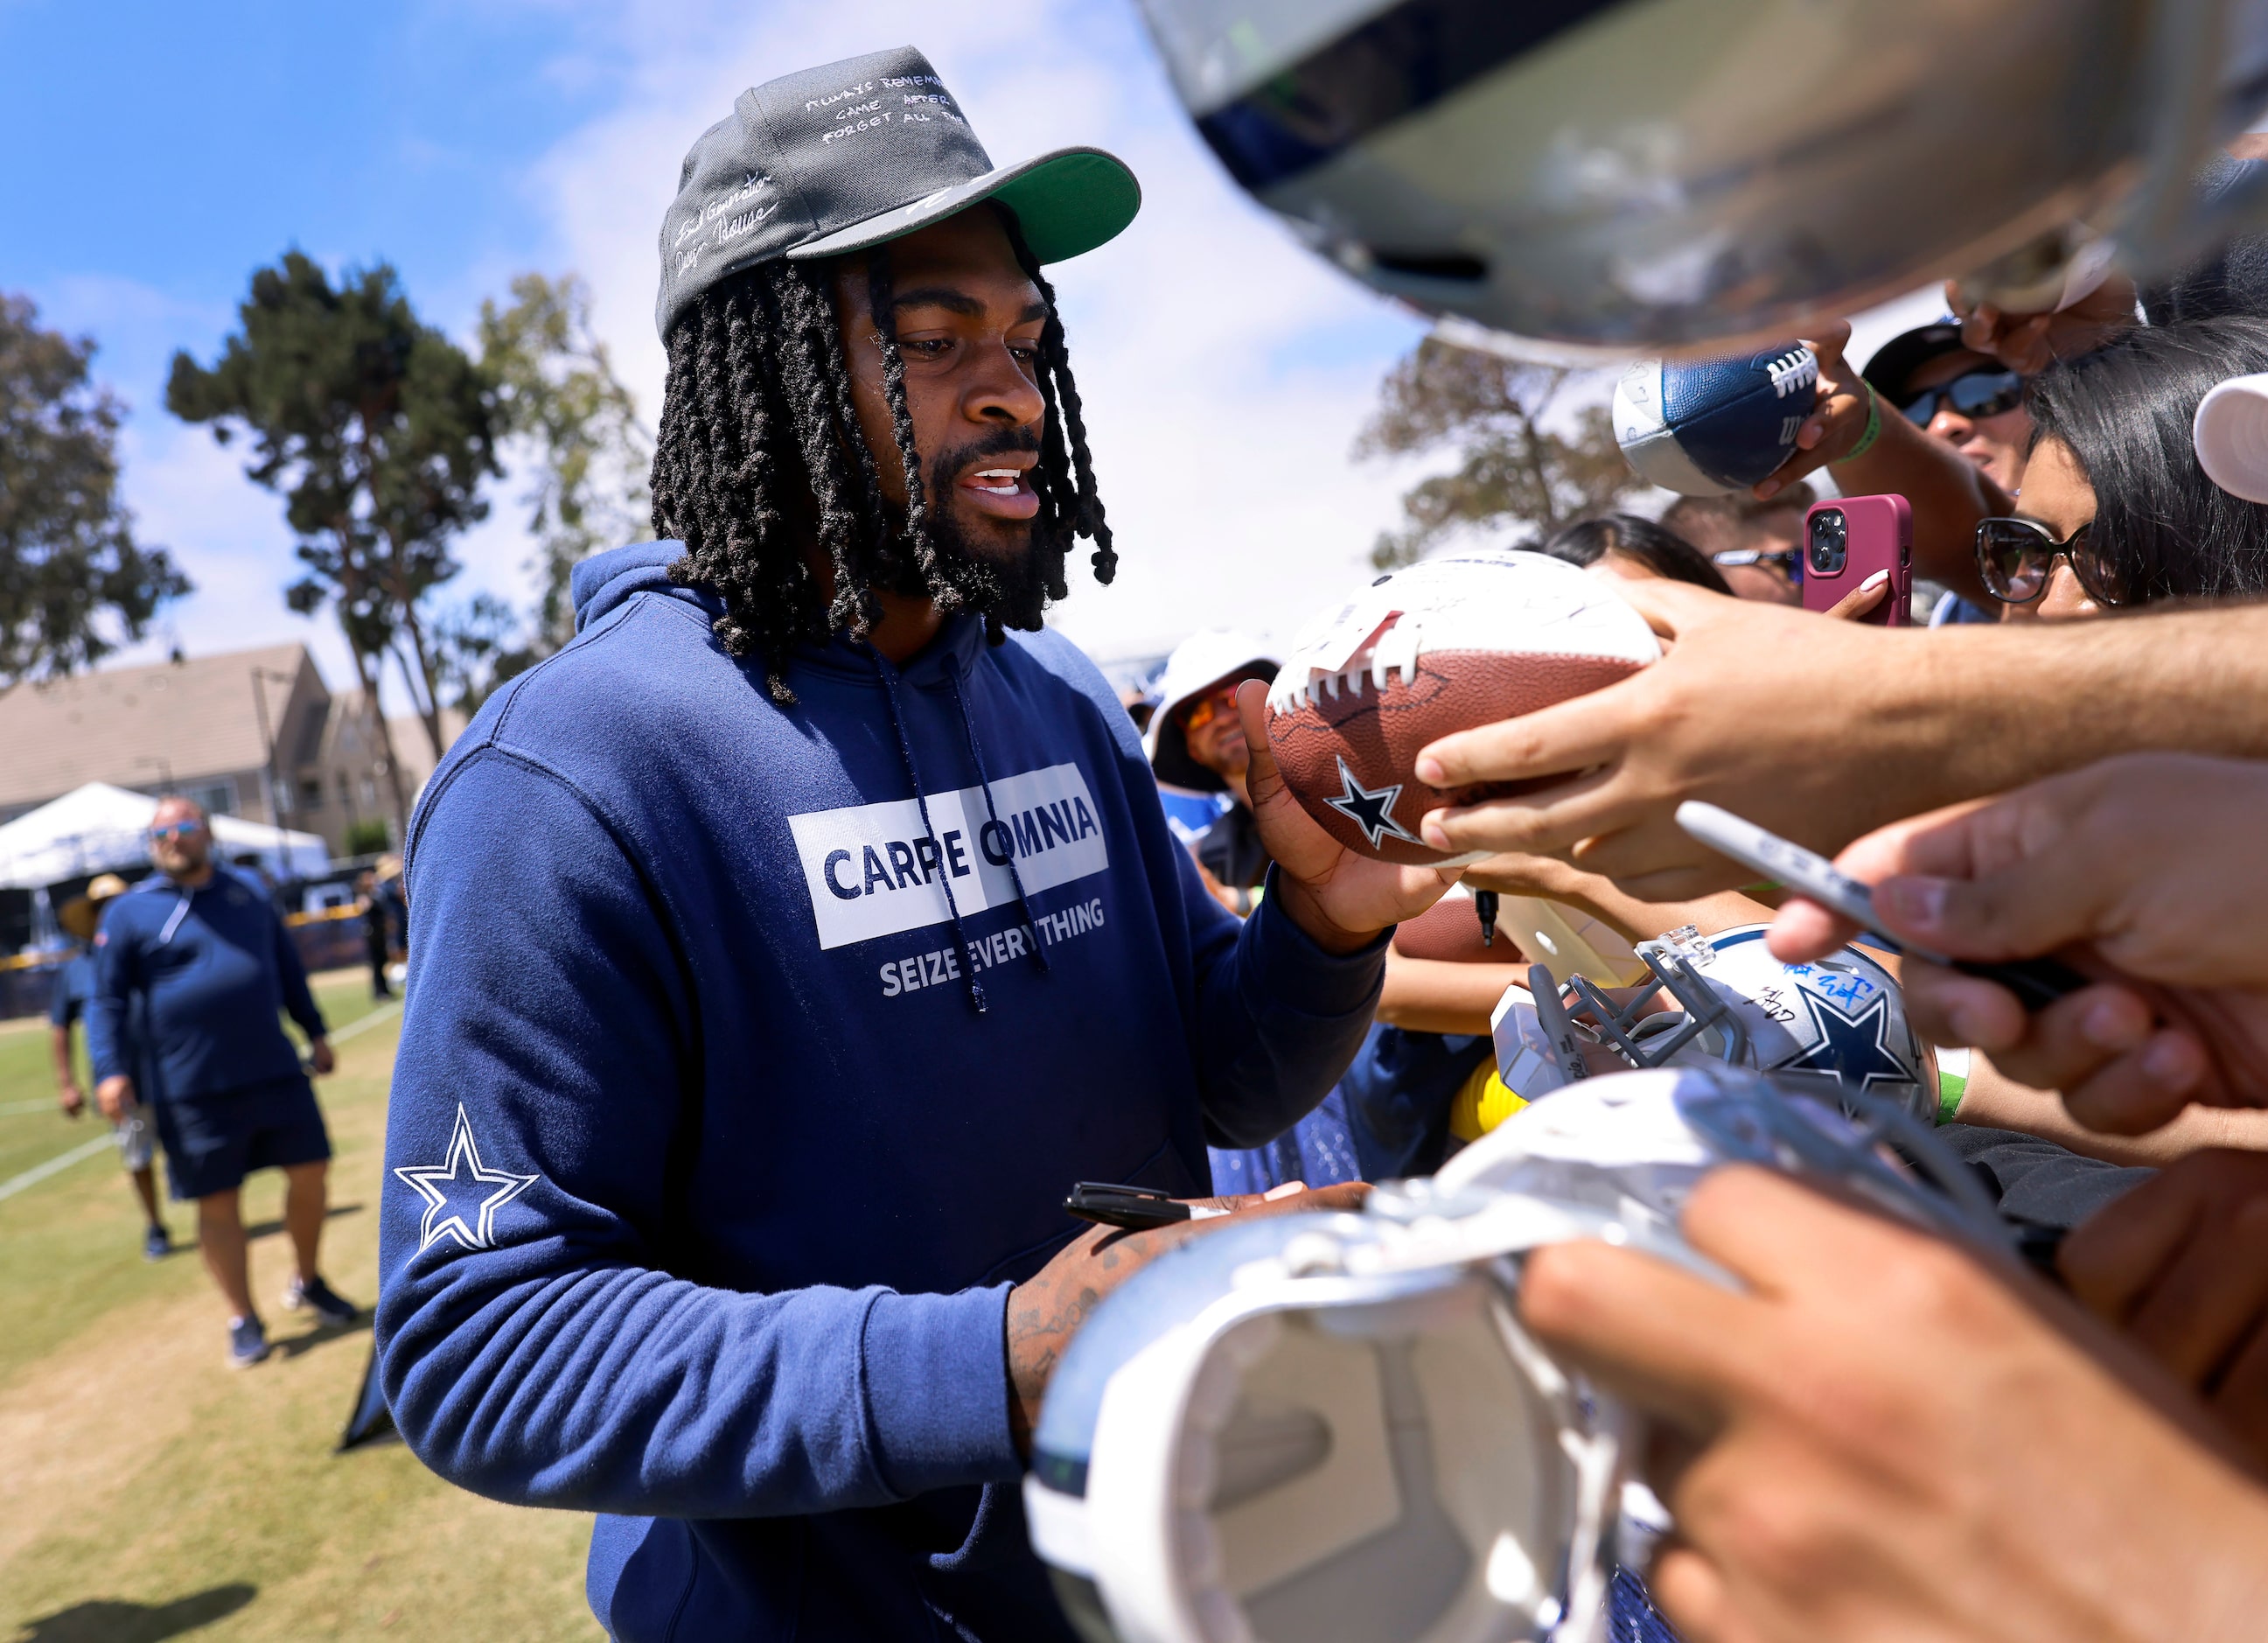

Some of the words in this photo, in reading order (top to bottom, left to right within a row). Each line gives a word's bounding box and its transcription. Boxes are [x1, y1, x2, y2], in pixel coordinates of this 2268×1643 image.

[822, 112, 892, 145] FORGET
[904, 113, 930, 123] ALL
[835, 100, 881, 121] CAME
[904, 94, 950, 106] AFTER
[707, 171, 772, 220] Generation
[712, 201, 778, 245] House
[824, 829, 970, 900] CARPE
[979, 796, 1098, 866] OMNIA
[879, 946, 961, 997] SEIZE
[967, 898, 1105, 973] EVERYTHING
